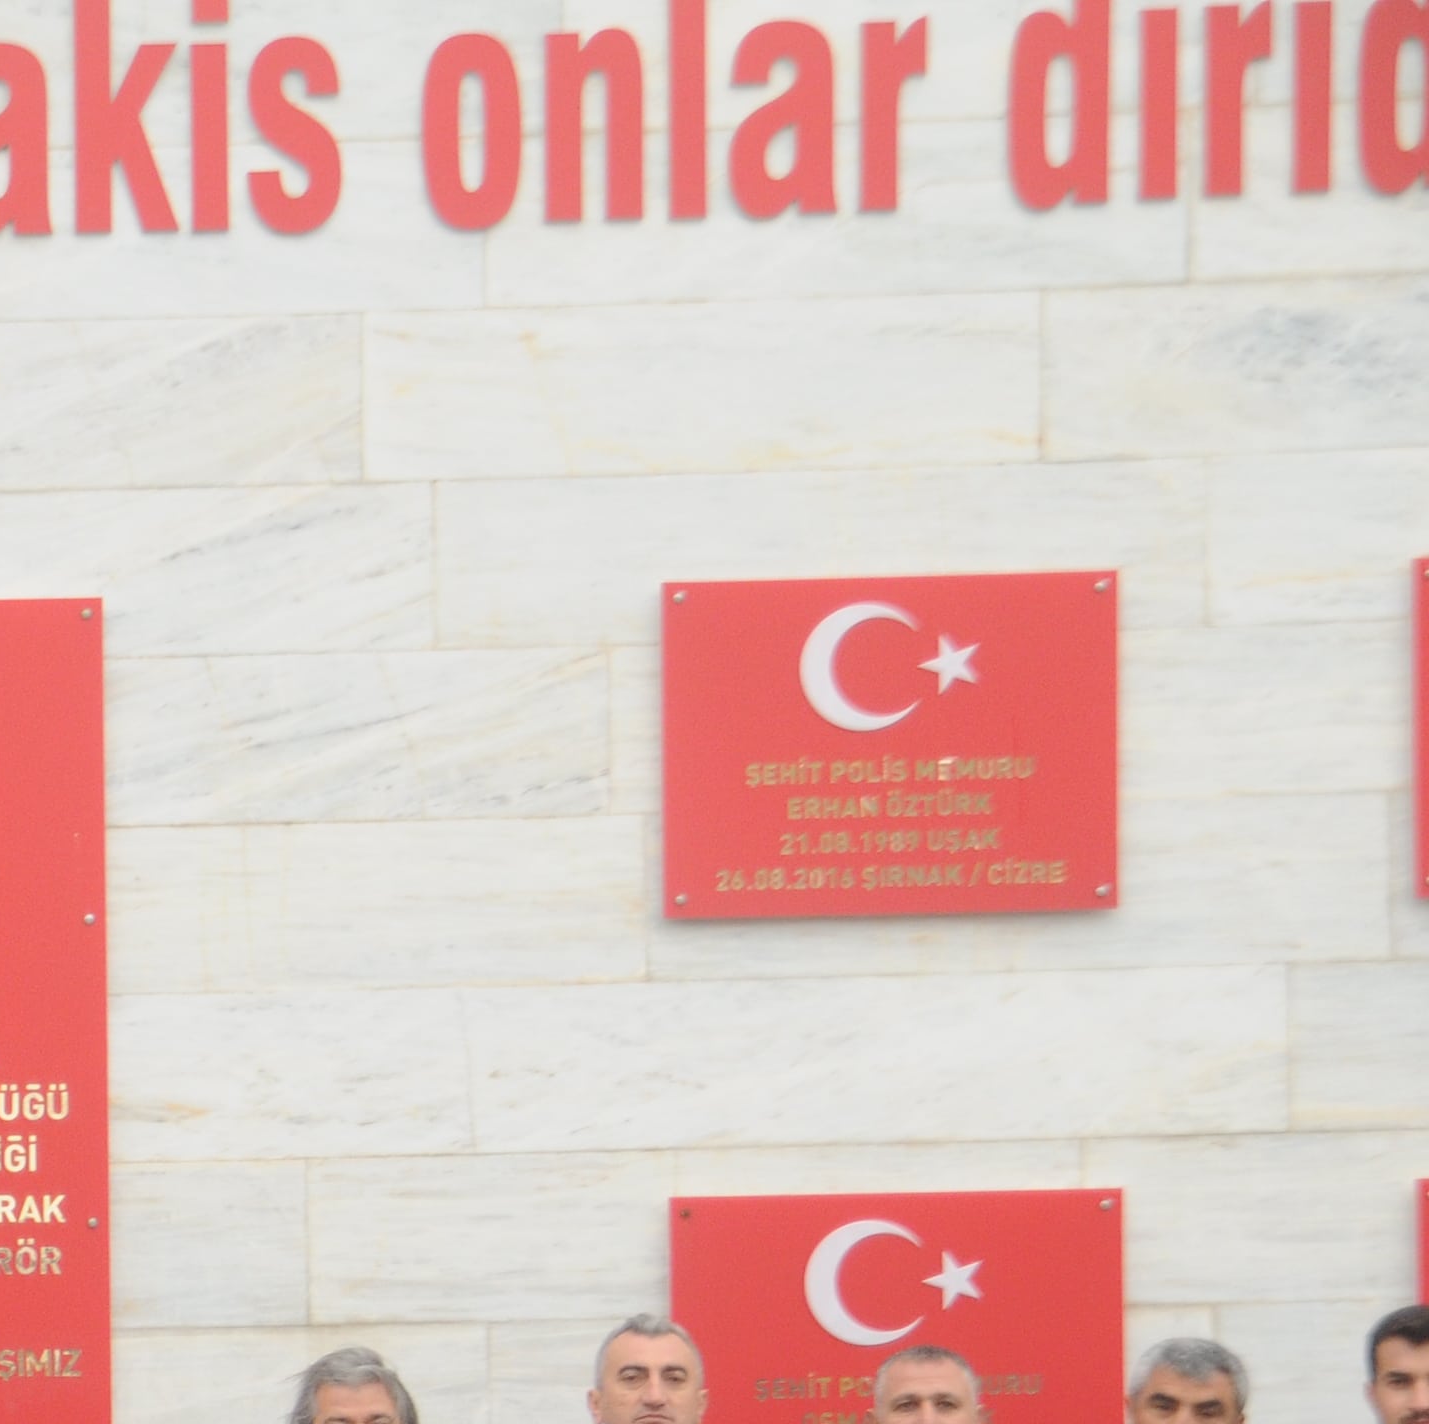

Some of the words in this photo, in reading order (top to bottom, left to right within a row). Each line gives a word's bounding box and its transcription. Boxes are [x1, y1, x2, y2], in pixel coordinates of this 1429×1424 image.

[422, 0, 928, 233] onlar
[746, 757, 824, 787] ŞEHİT
[830, 755, 909, 783] POLİS
[915, 756, 1035, 781] MEMURU
[788, 796, 880, 820] ERHAN
[886, 788, 992, 817] ÖZTÜRK
[928, 828, 999, 853] UŞAK
[862, 864, 963, 890] ŞIRNAK
[988, 858, 1066, 885] CİZRE
